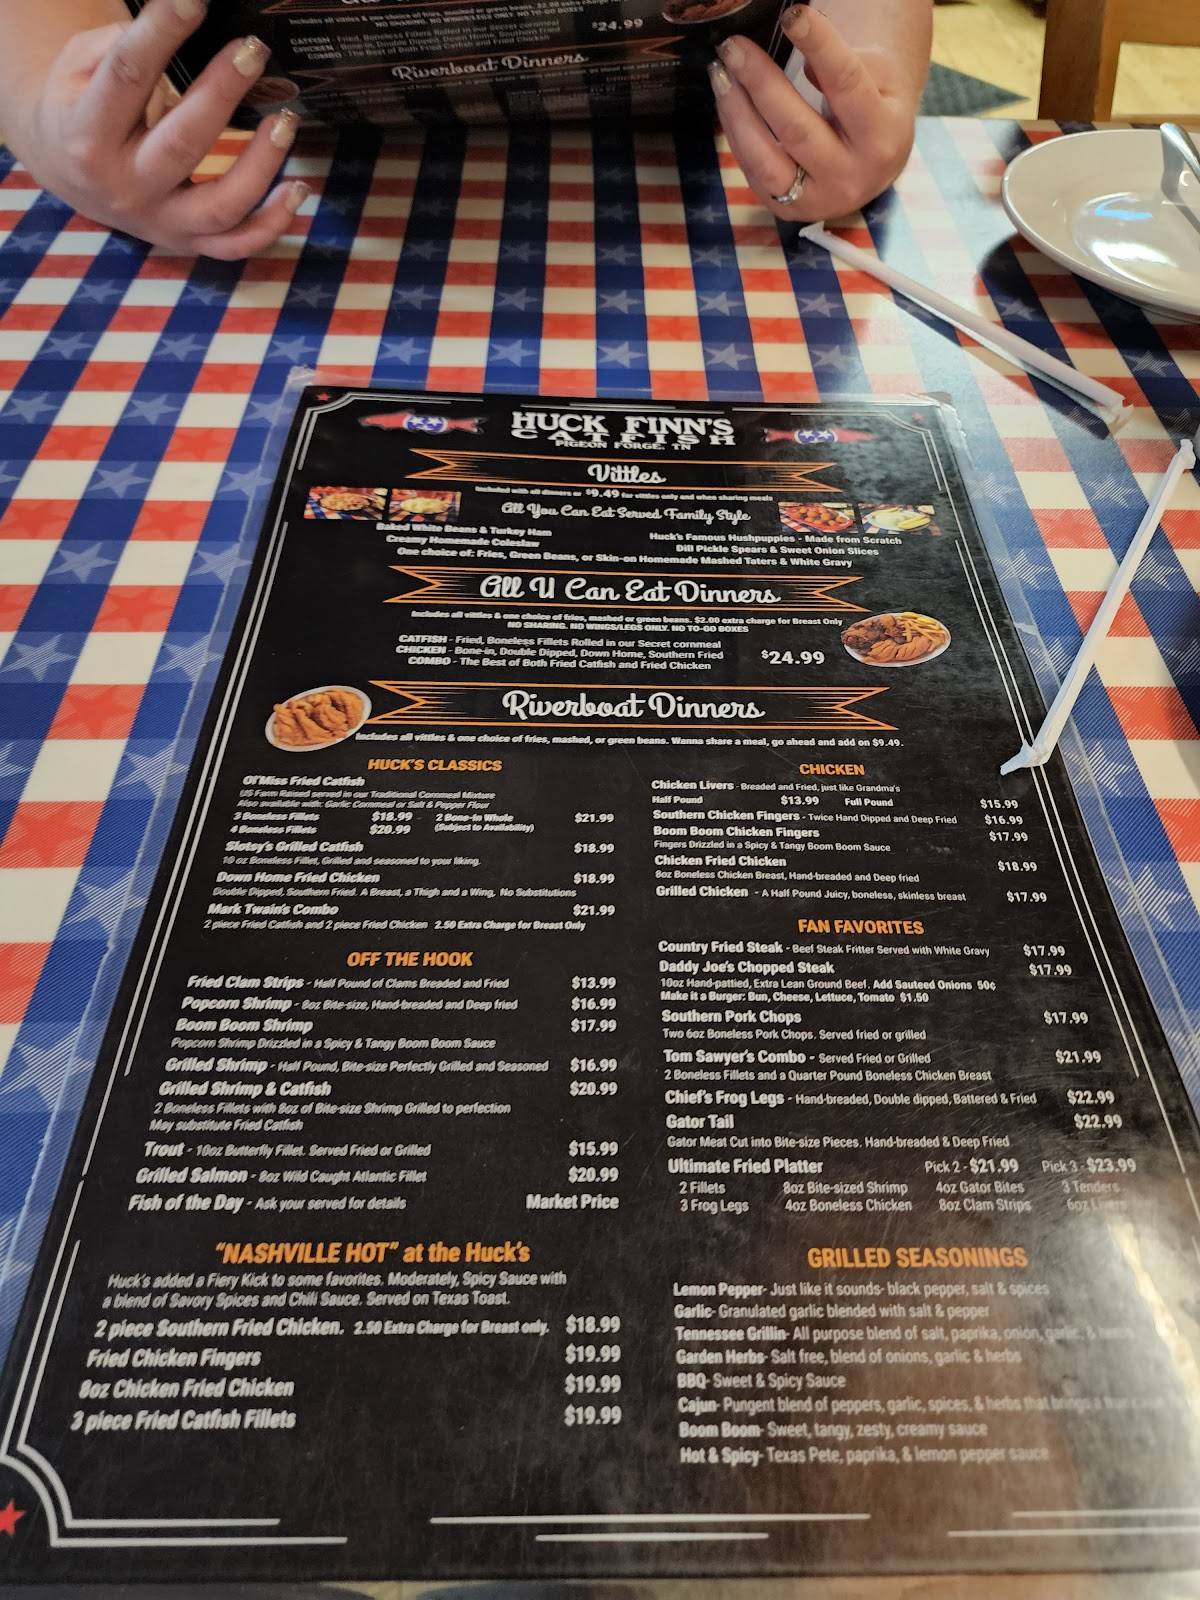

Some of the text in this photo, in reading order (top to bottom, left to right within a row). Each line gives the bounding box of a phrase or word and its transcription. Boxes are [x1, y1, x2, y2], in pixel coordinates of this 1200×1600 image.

[591, 18, 644, 32] $24.99
[391, 57, 499, 81] Riverboat
[501, 52, 589, 70] Dinners
[511, 411, 735, 436] HUCK FINN'S
[511, 428, 736, 446] CATFISH
[674, 443, 691, 451] TN
[587, 463, 667, 484] Vittles
[501, 502, 751, 525] All You Can Eat Served Family Style
[375, 521, 552, 537] Baked White Beans & Turkey Ham
[648, 532, 684, 540] Huck's
[685, 532, 726, 541] Famous
[727, 533, 795, 543] Hushpuppies
[804, 534, 834, 543] Made
[835, 535, 860, 543] from
[862, 536, 902, 544] Scratch
[675, 543, 879, 555] Dill Pickle Spears & Sweet Onion Slices
[479, 574, 782, 604] All U Can Eat Dinners
[407, 655, 451, 665] COMBO
[459, 656, 480, 666] The
[481, 657, 506, 666] Best
[507, 657, 521, 666] of
[521, 658, 548, 667] Both
[549, 658, 577, 668] Fried
[578, 659, 616, 668] Catfish
[617, 660, 638, 669] and
[639, 660, 667, 669] Fried
[668, 661, 711, 670] Chicken
[760, 649, 825, 664] $24.99
[502, 689, 766, 721] Riverboat Dinners
[367, 758, 502, 771] HUCK'S CLASSICS
[798, 763, 865, 775] CHICKEN
[650, 779, 734, 790] Chicken Livers
[780, 794, 819, 806] $13.99
[844, 797, 894, 806] Full Pound
[979, 797, 1018, 809] $15.99
[574, 812, 614, 823] $21.99
[652, 809, 800, 822] Southern Chicken Fingers
[984, 813, 1023, 825] $16.99
[215, 871, 380, 883] Down Home Fried Chicken
[573, 871, 615, 884] $18.99
[797, 918, 924, 935] FAN FAVORITES
[657, 940, 783, 955] Country Fried Steak
[1022, 943, 1065, 957] $17.99
[346, 951, 473, 967] OFF THE HOOK
[186, 974, 305, 991] Fried Clam Strips
[571, 975, 616, 990] $13.99
[571, 996, 616, 1011] $16.99
[570, 1017, 617, 1033] $17.99
[662, 1027, 926, 1042] Two 6oz Boneless Pork Chops. Served fried or grilled
[569, 1080, 618, 1096] $20.99
[665, 1113, 734, 1129] Gator Tail
[1073, 1112, 1123, 1130] $22.99
[568, 1140, 618, 1157] $15.99
[667, 1157, 823, 1174] Ultimate Fried Platter
[969, 1157, 1019, 1174] $21.99
[1086, 1157, 1136, 1174] $23.99
[679, 1180, 726, 1194] 2 Fillets
[782, 1180, 908, 1196] 8oz Bite-sized Shrimp
[935, 1180, 1025, 1194] 4oz Gator Bites
[525, 1193, 619, 1209] Market Price
[402, 1243, 424, 1263] at
[427, 1240, 461, 1262] the
[464, 1240, 530, 1262] Huck's
[807, 1247, 1028, 1268] GRILLED SEASONINGS
[107, 1270, 567, 1290] Huck's added a Fiery Kick to some favorites. Moderately, Spicy Sauce with
[565, 1315, 620, 1334] $18.99
[86, 1347, 262, 1369] Fried Chicken Fingers
[564, 1344, 621, 1364] $19.99
[676, 1372, 846, 1391] BBQ- Sweet & Spicy Sauce
[564, 1406, 622, 1426] $19.99
